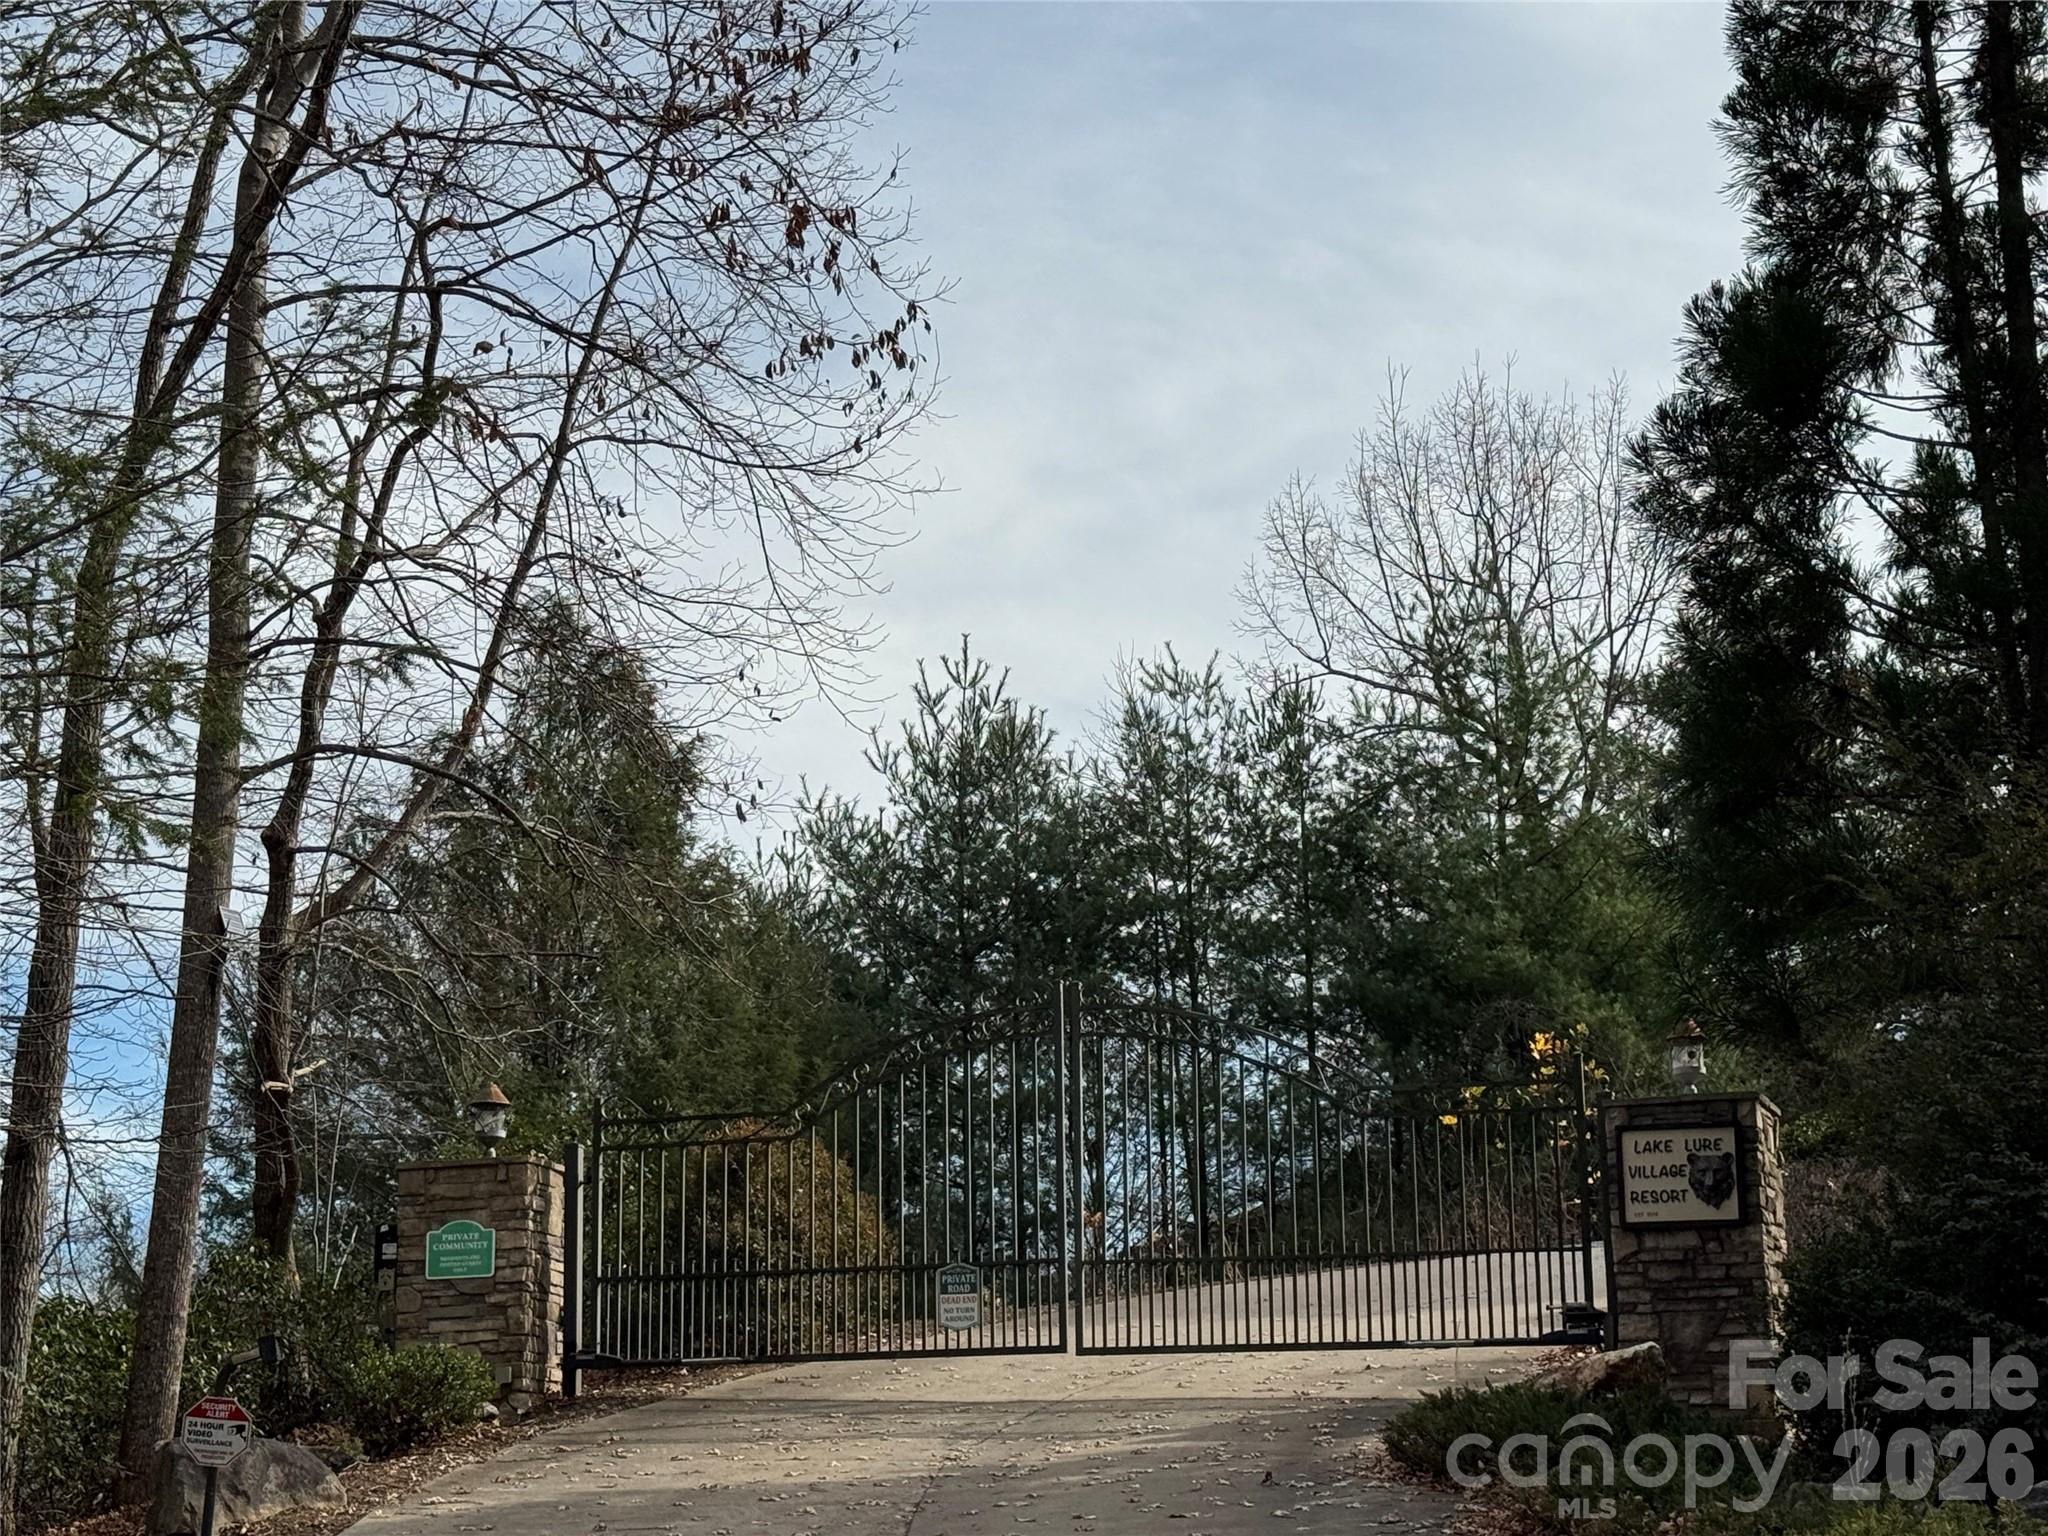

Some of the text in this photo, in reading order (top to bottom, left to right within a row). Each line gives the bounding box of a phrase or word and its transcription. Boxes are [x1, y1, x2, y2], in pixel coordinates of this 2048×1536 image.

[1633, 1137, 1723, 1154] LAKE LURE
[1628, 1164, 1688, 1179] VILLAGE
[1630, 1189, 1688, 1205] RESORT
[442, 1232, 480, 1241] PRIVATE
[433, 1240, 489, 1251] COMMUNITY
[942, 1273, 977, 1284] PRIVATE
[947, 1284, 971, 1293] ROAD
[941, 1295, 977, 1305] DEAD END
[955, 1306, 975, 1314] TURN
[201, 1402, 237, 1412] SECURITY
[206, 1410, 230, 1419] ALERT
[188, 1420, 224, 1431] 24 HOUR
[187, 1428, 213, 1438] VIDEO
[186, 1437, 233, 1448] SURVEILLANCE
